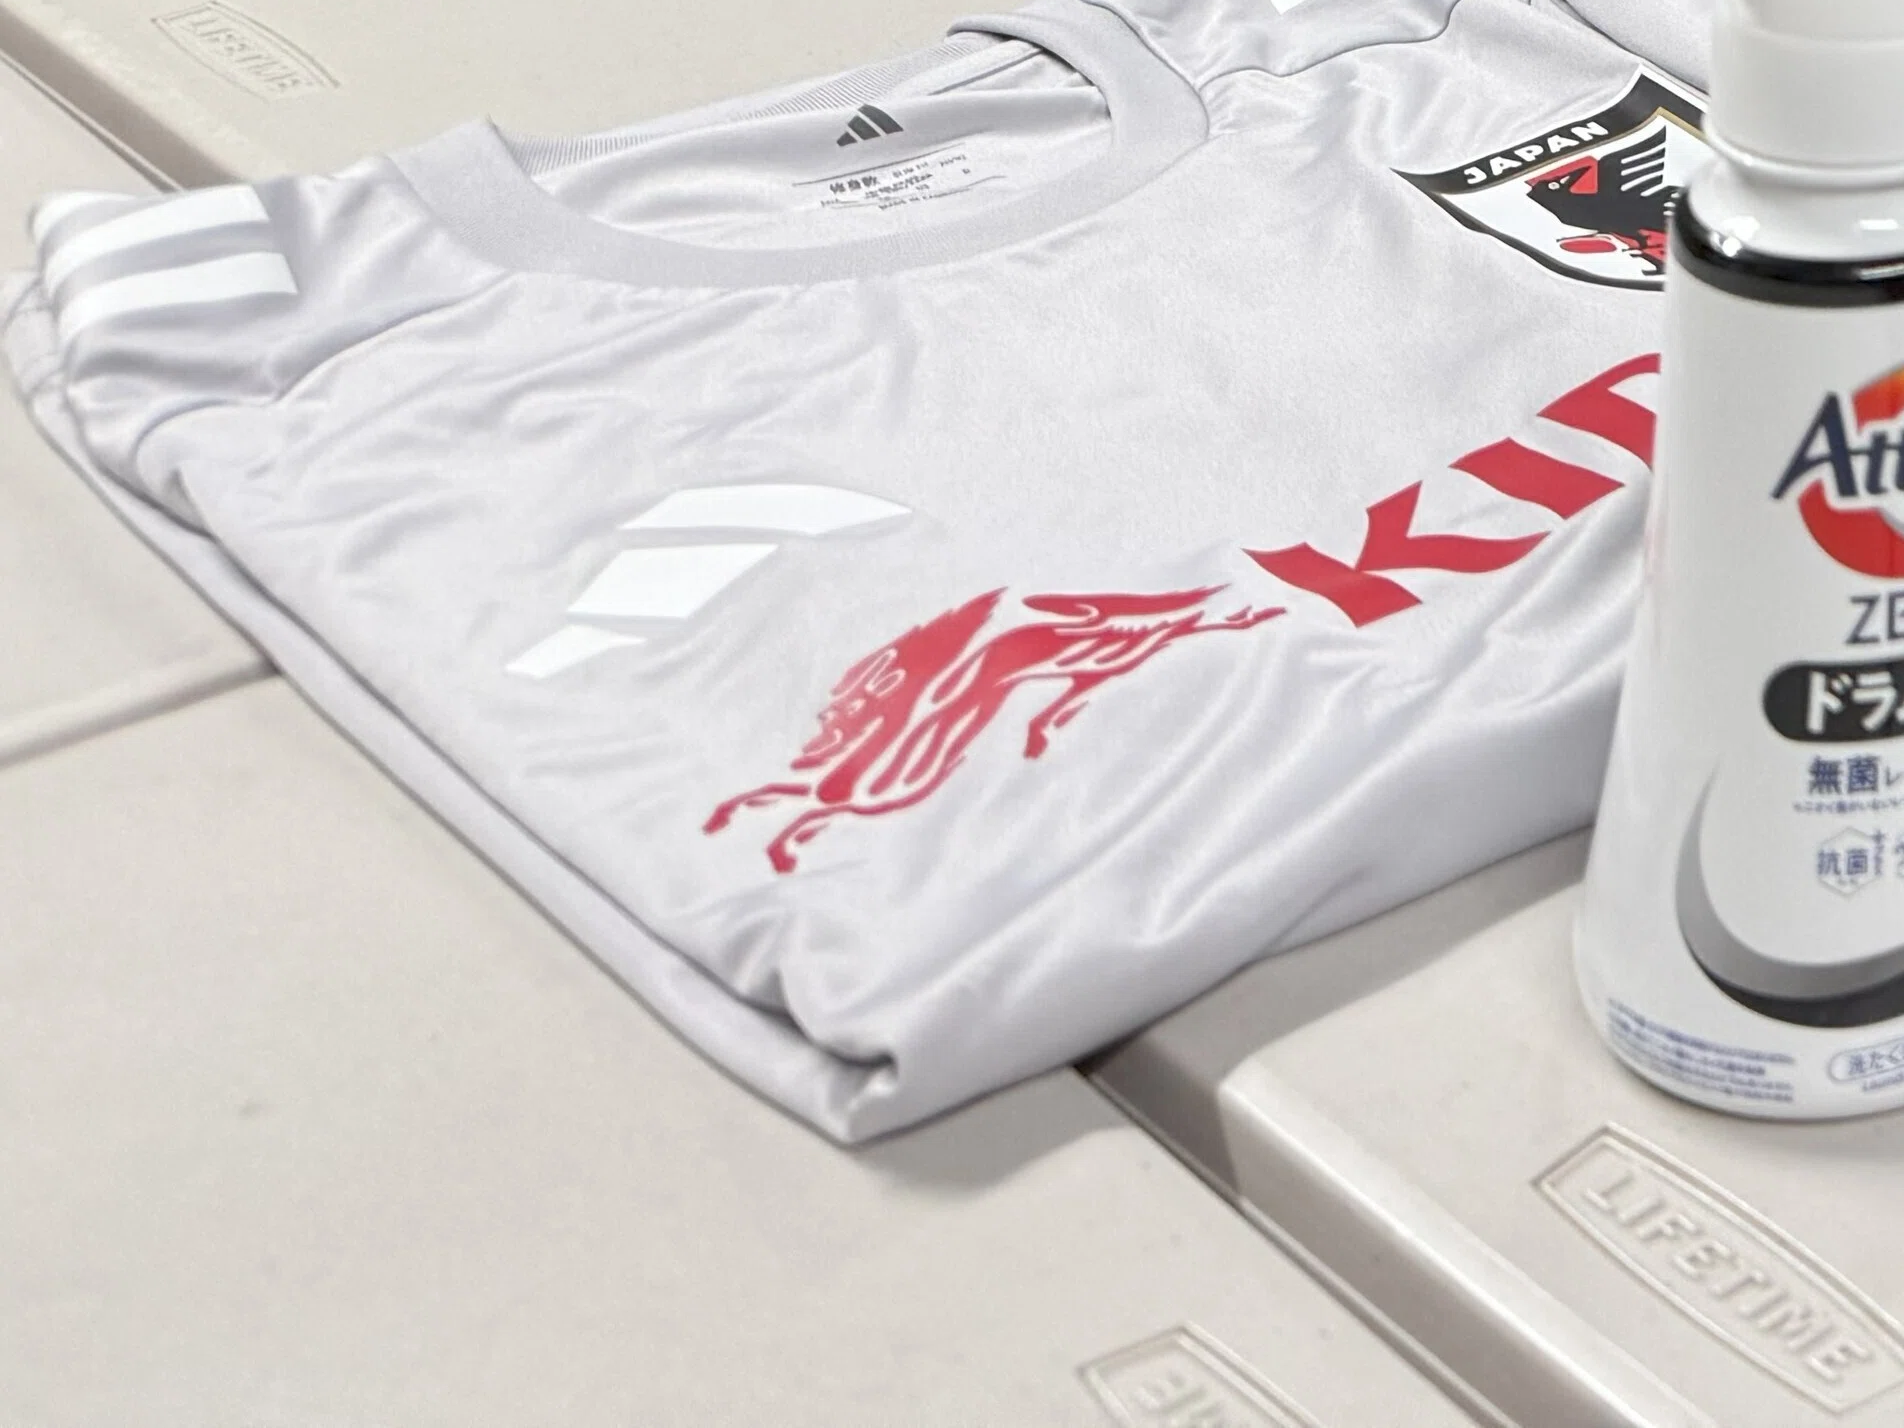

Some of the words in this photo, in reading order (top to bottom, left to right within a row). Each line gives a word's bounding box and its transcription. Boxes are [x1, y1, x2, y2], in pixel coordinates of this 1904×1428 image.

[1464, 120, 1609, 185] JAPAN
[1817, 849, 1869, 875] 抗菌
[1583, 1170, 1875, 1382] LIFETIME
